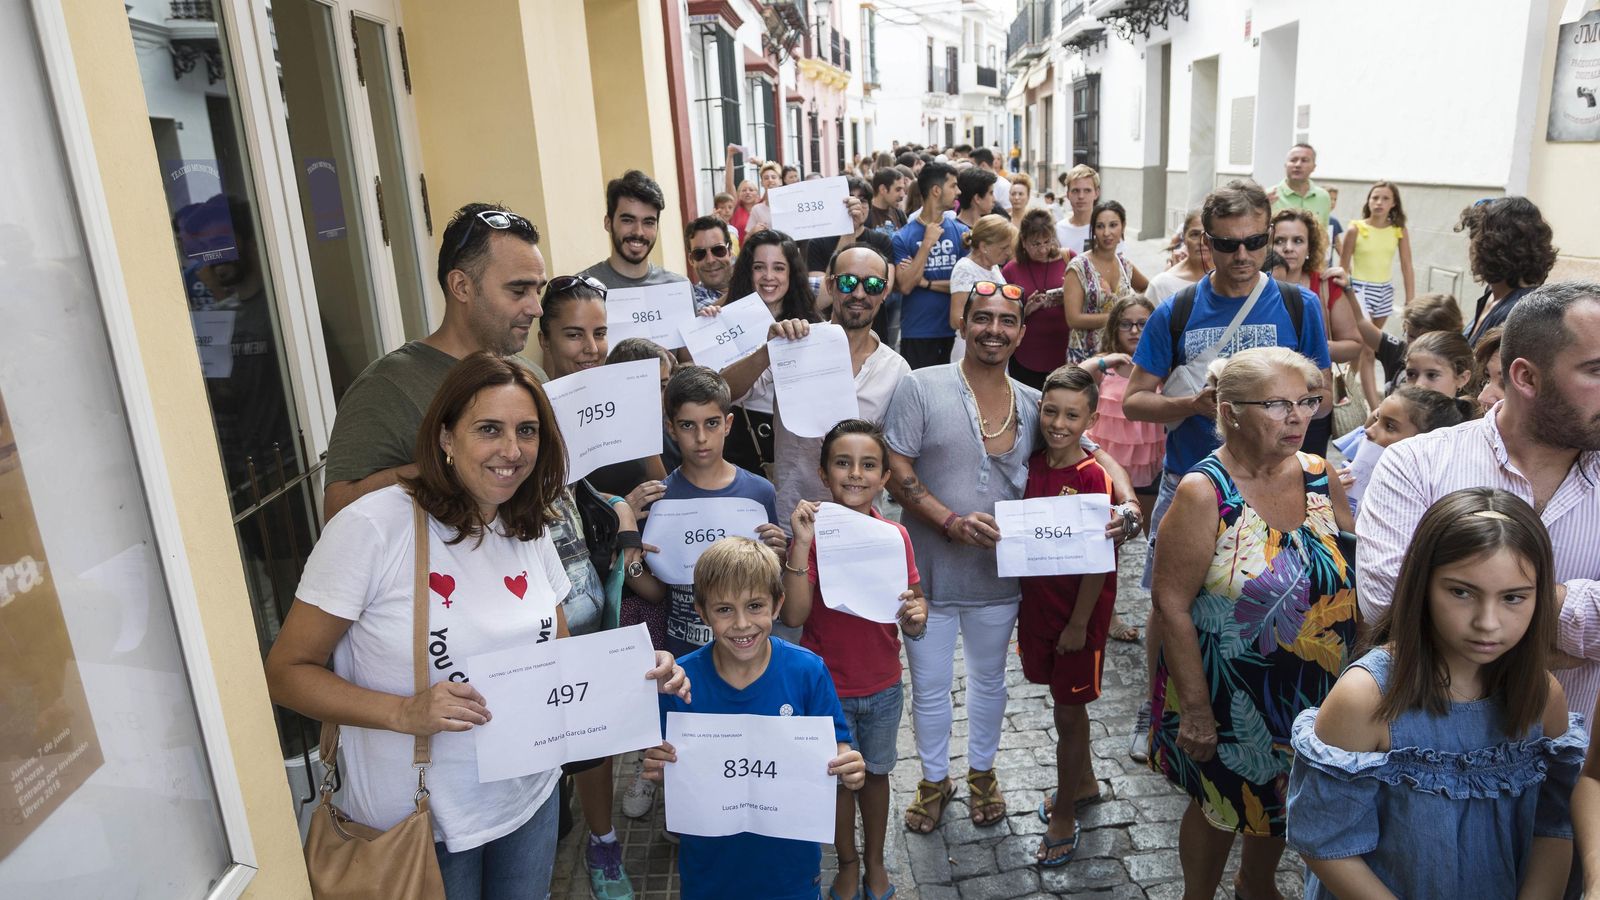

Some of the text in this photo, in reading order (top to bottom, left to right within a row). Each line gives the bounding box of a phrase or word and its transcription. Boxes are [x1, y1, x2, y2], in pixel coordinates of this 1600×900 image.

[797, 200, 825, 213] 8338
[632, 309, 663, 324] 9861
[715, 324, 746, 345] 8551
[576, 401, 616, 428] 7959
[1034, 525, 1073, 540] 8564
[429, 627, 454, 670] YOU
[546, 681, 589, 707] 497
[37, 747, 43, 758] 7
[44, 740, 53, 754] de
[53, 727, 71, 749] junio
[534, 738, 547, 747] Ana
[14, 764, 46, 794] 20 horas
[723, 757, 778, 779] 8344
[18, 778, 47, 807] Entrada
[46, 767, 59, 784] por
[22, 796, 45, 819] Utrera
[44, 779, 61, 799] 2018
